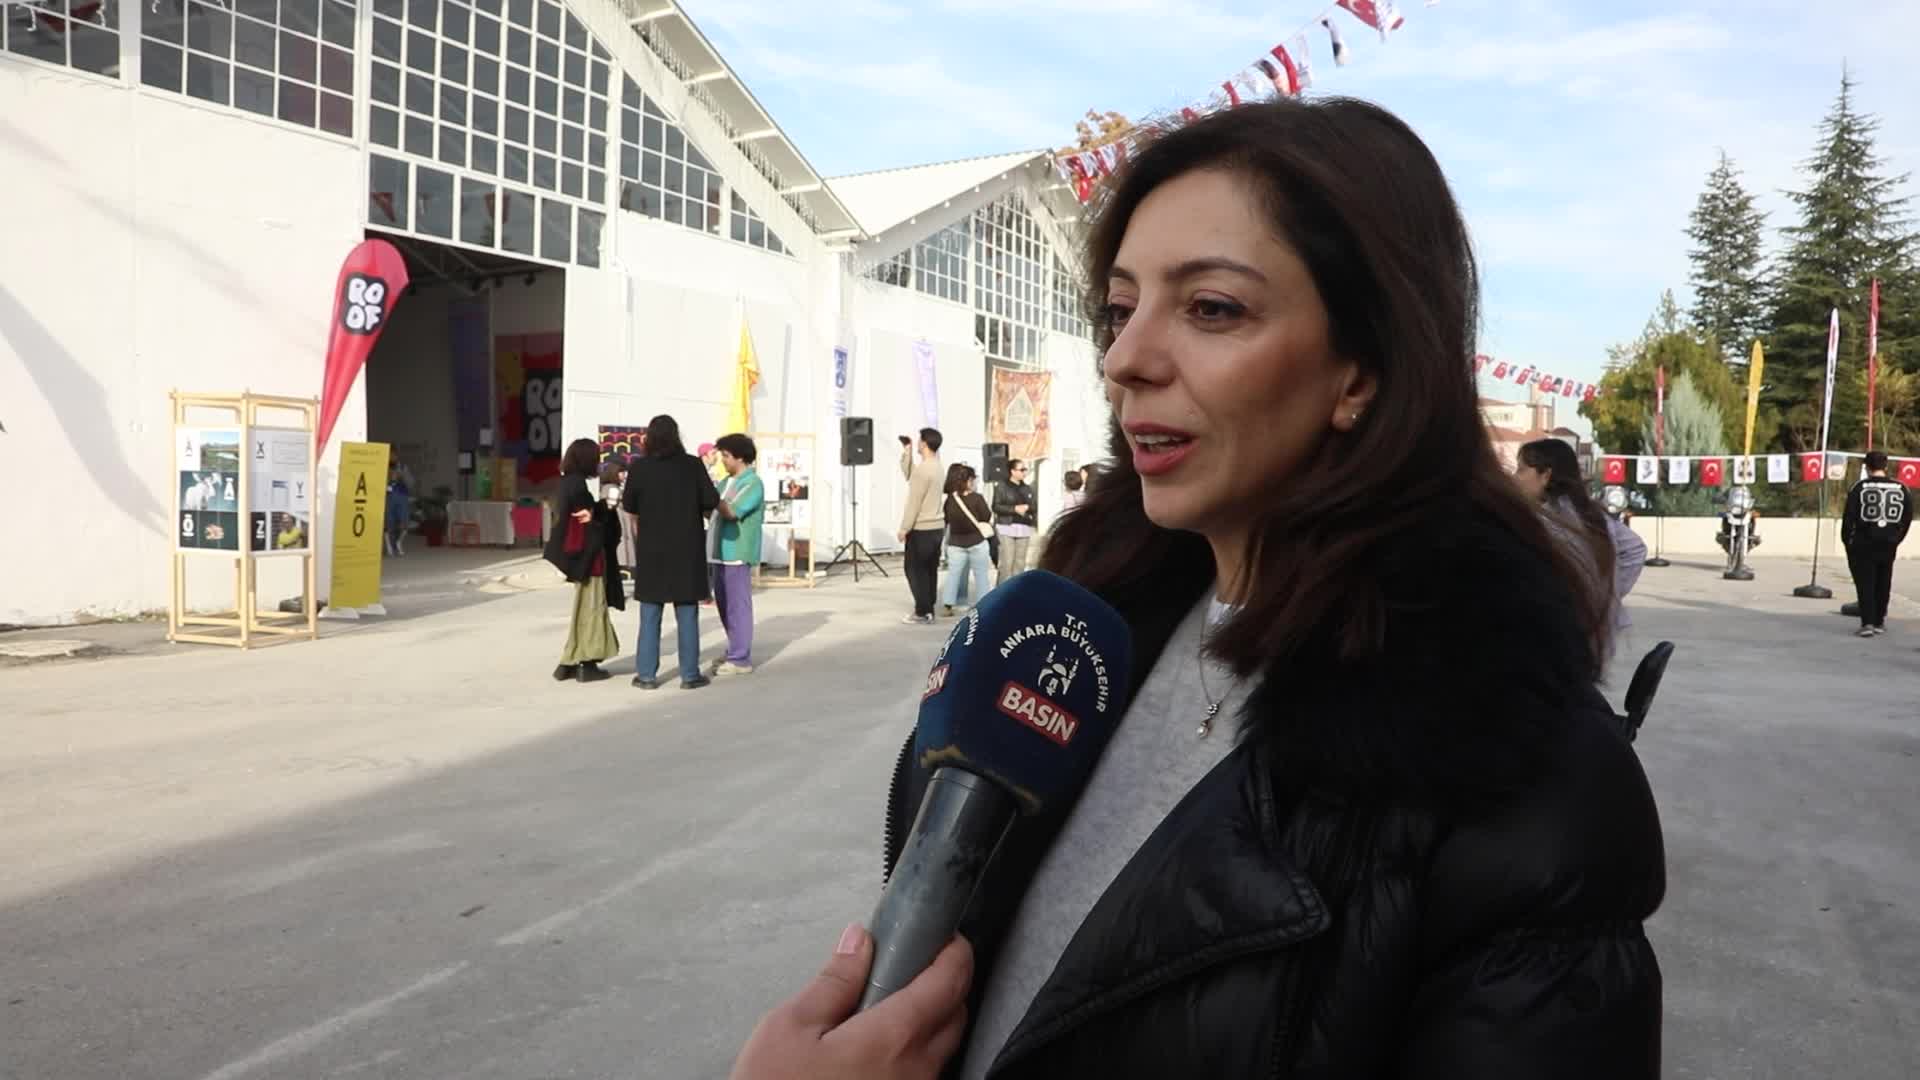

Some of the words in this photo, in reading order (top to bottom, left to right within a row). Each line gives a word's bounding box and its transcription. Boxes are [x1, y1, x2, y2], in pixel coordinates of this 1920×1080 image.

[349, 278, 384, 306] RO
[346, 305, 381, 330] OF
[1860, 488, 1904, 523] 86
[1000, 623, 1057, 658] ANKARA
[1002, 687, 1075, 740] BASIN
